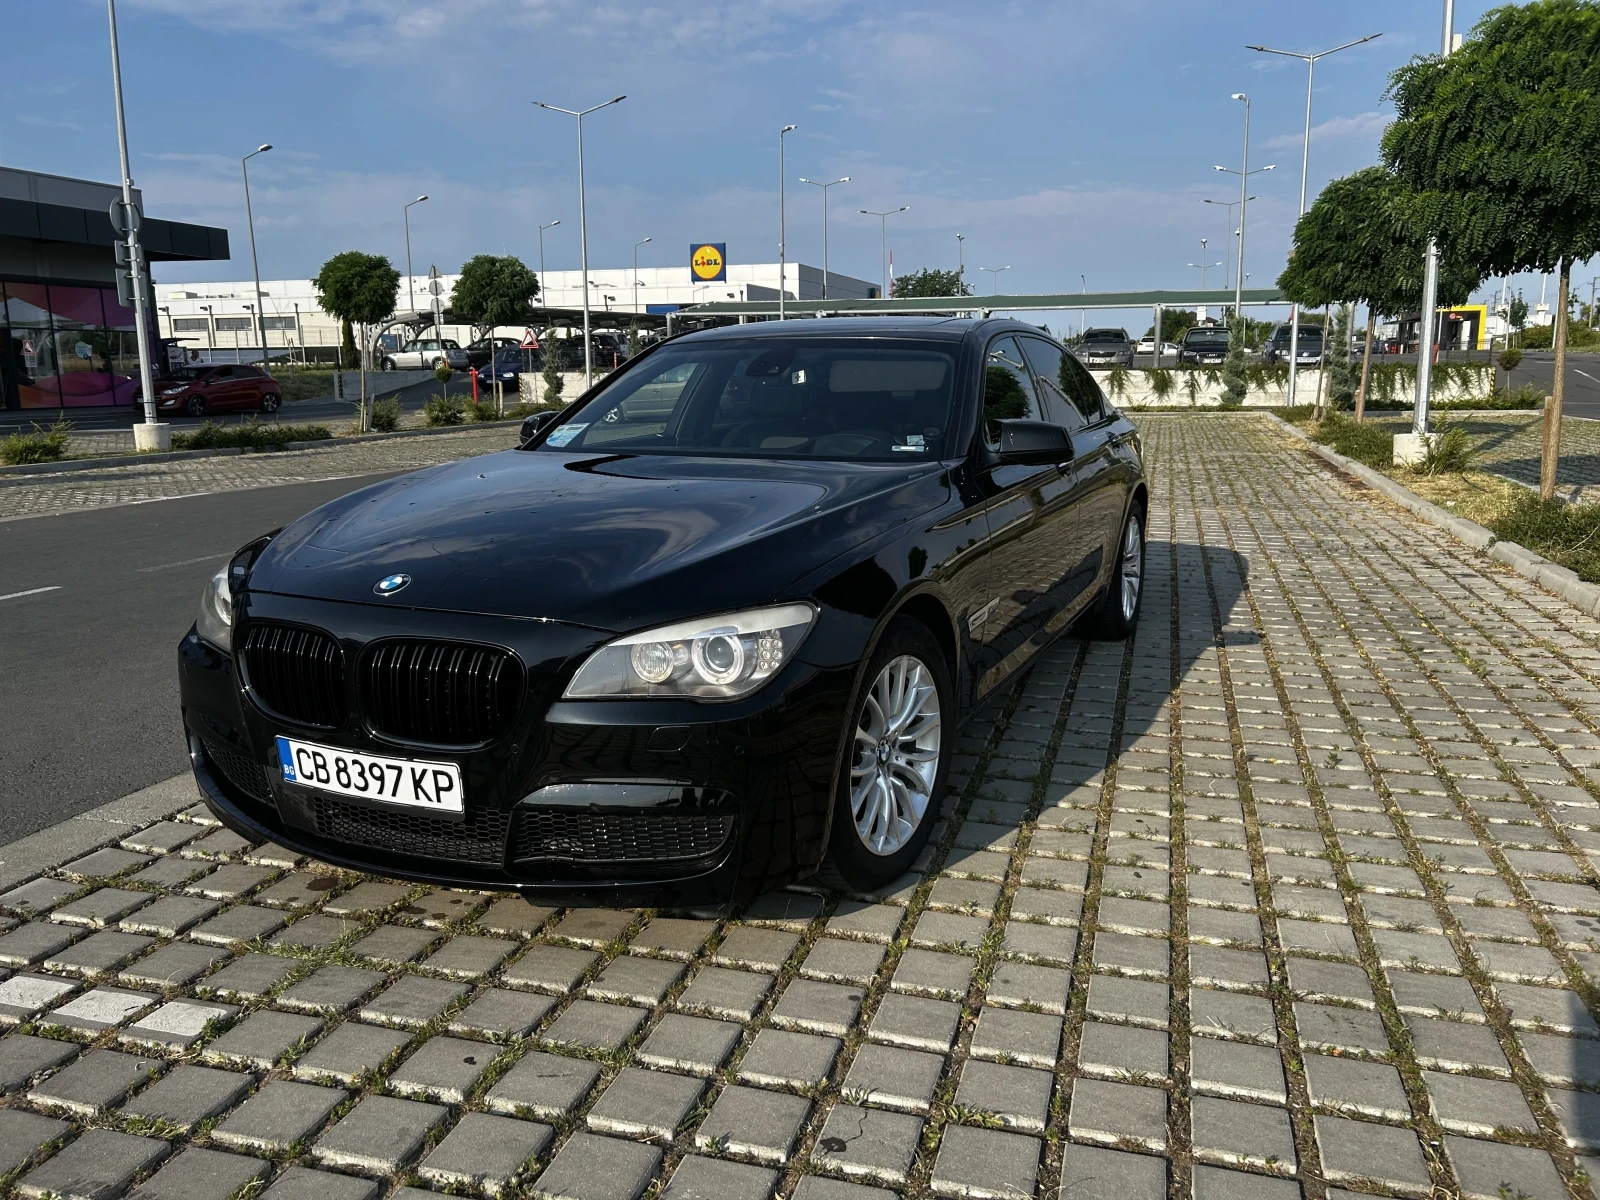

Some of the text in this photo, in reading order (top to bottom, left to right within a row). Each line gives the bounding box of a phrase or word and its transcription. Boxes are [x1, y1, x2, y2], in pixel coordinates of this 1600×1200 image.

[284, 764, 295, 776] BG
[296, 748, 454, 803] CB 8397 KP
